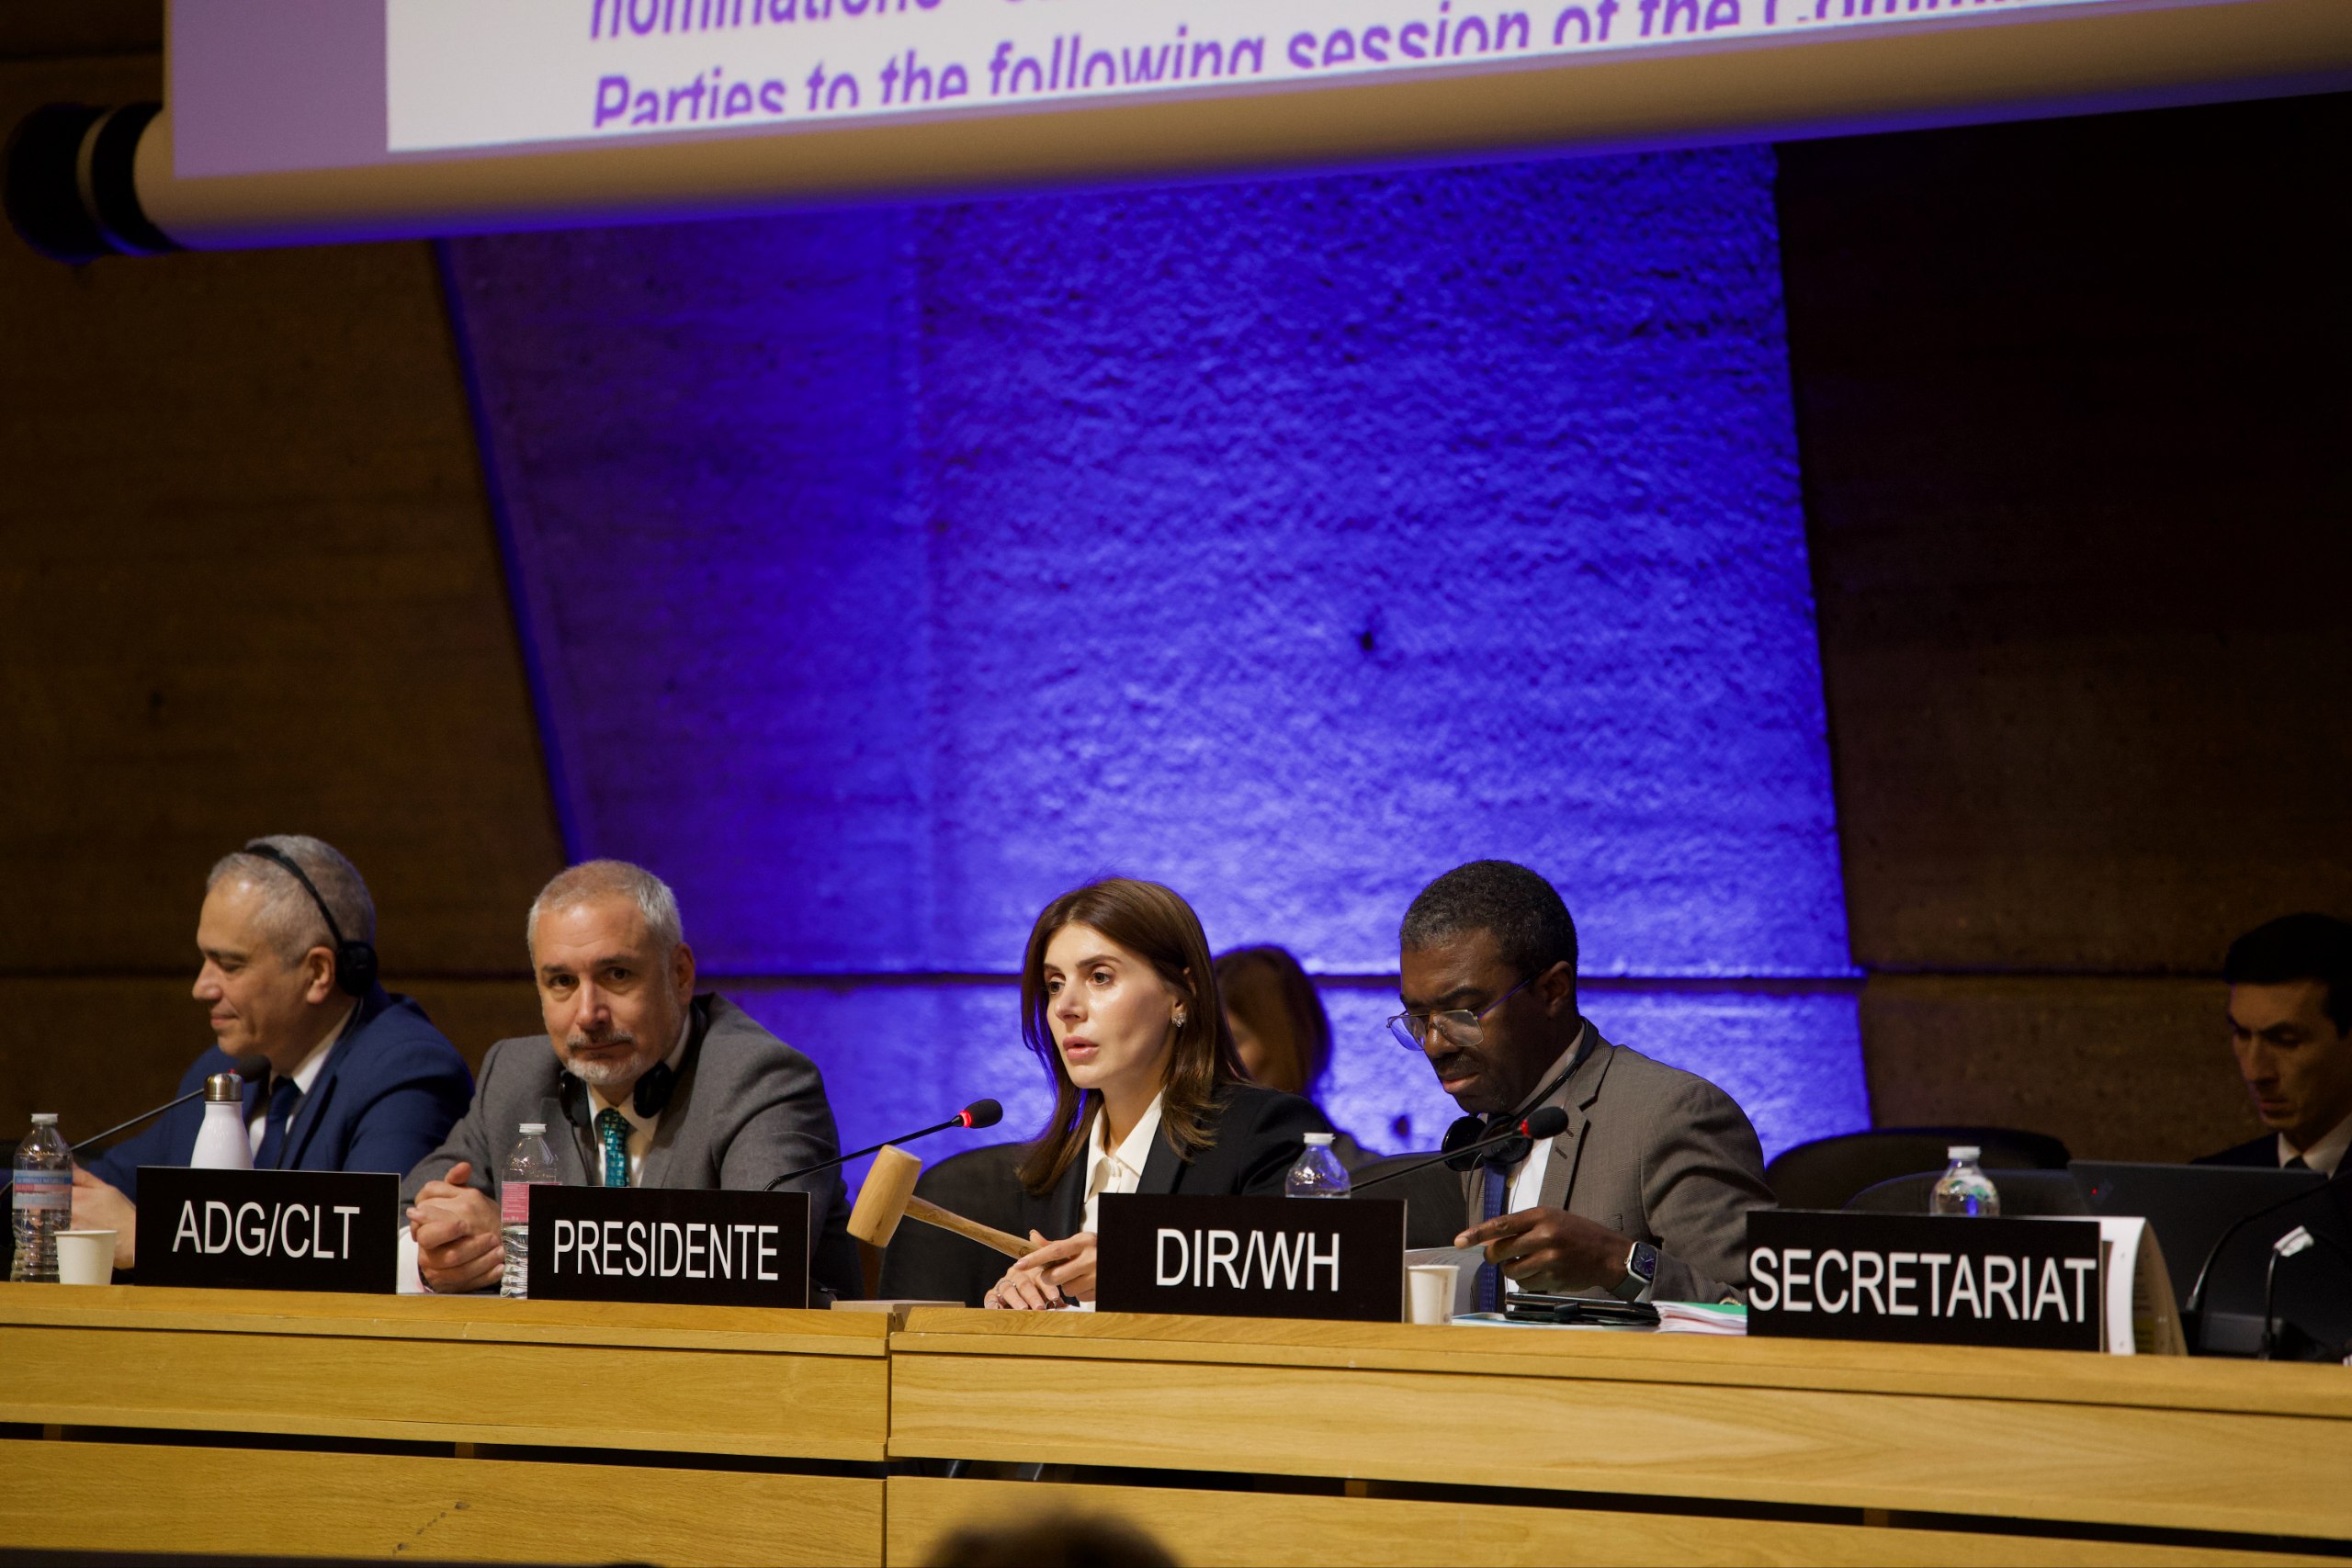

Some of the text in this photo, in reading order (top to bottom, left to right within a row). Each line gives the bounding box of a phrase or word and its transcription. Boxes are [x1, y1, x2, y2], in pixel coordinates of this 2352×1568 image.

[594, 67, 786, 128] Parties
[807, 61, 860, 111] to
[879, 50, 968, 105] the
[1287, 0, 1530, 70] session
[172, 1200, 360, 1259] ADG/CLT
[553, 1219, 779, 1280] PRESIDENTE
[1156, 1228, 1340, 1292] DIR/WH
[1748, 1247, 2097, 1323] SECRETARIAT
